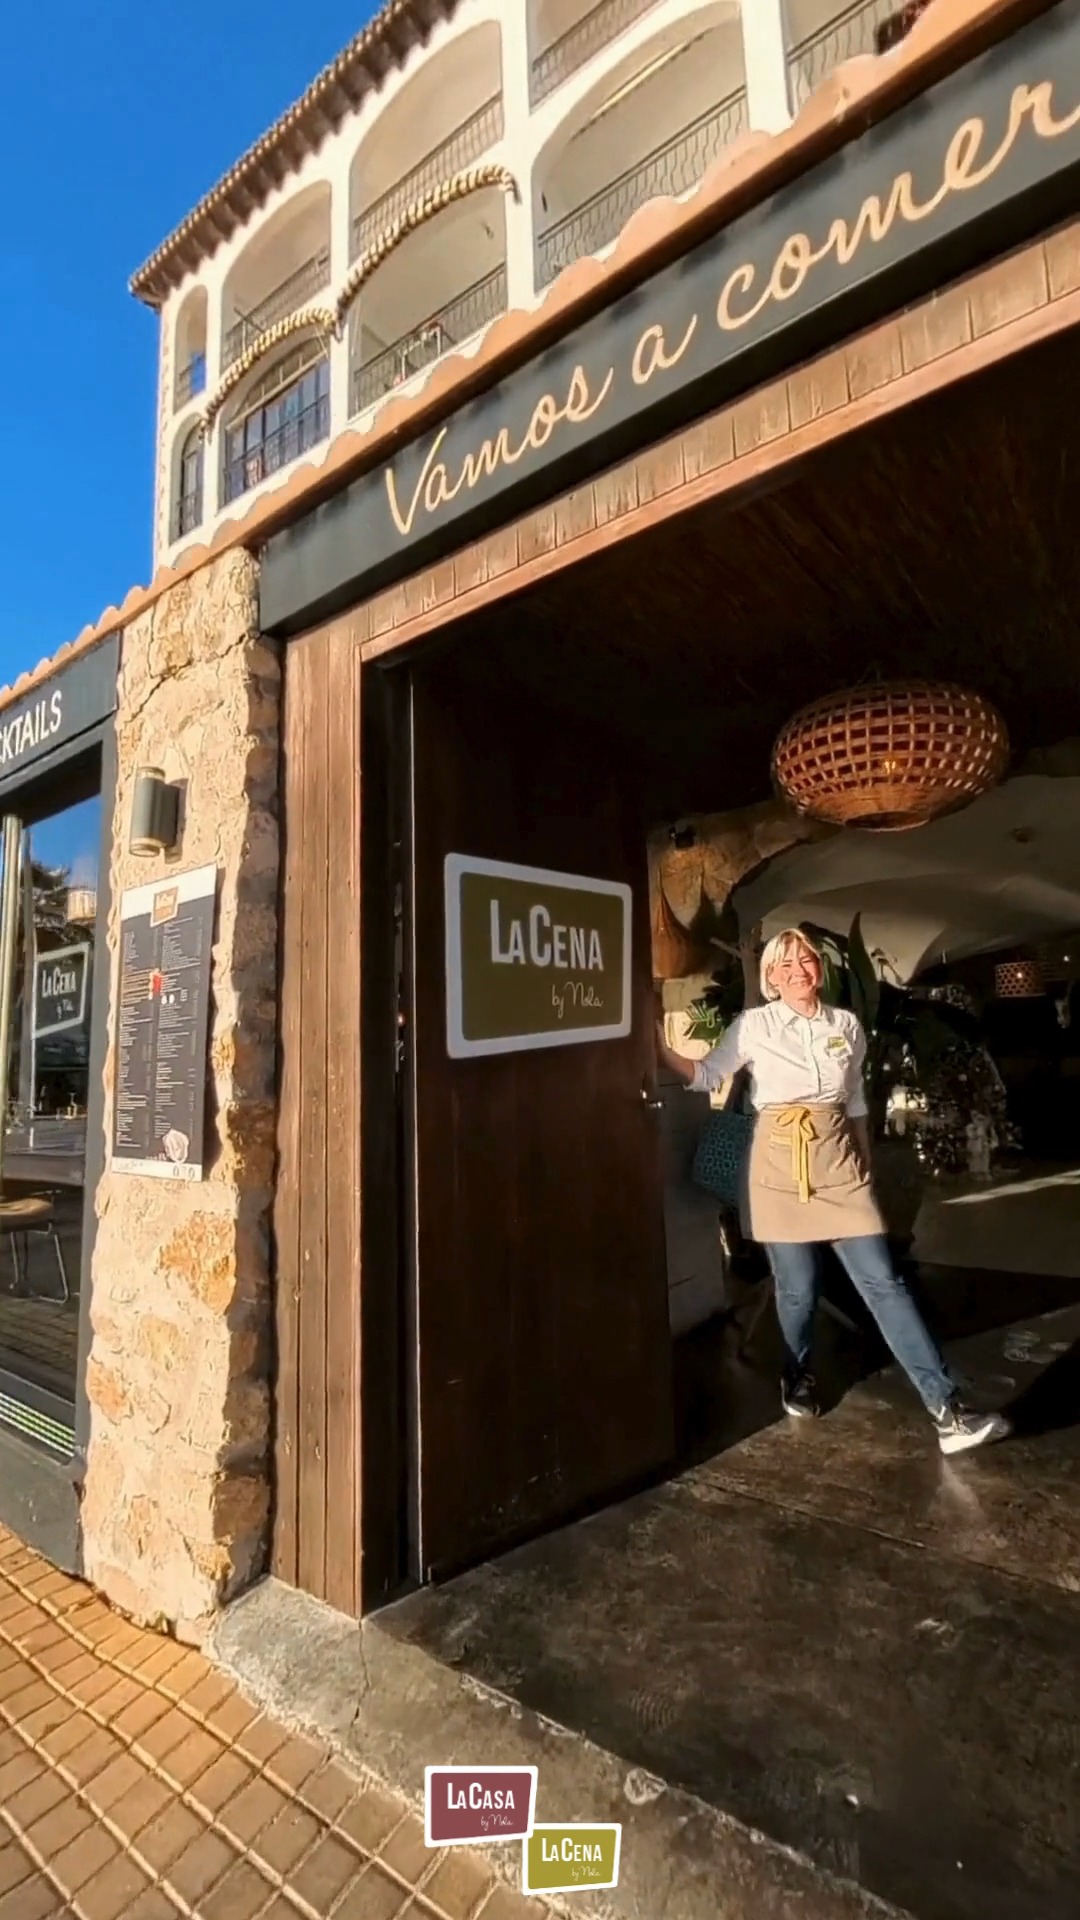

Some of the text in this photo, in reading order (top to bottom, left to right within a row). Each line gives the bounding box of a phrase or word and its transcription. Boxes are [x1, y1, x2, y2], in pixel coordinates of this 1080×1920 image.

[386, 79, 1080, 533] Vamos a comer
[0, 689, 62, 764] KTAILS
[551, 981, 603, 1019] by Nola
